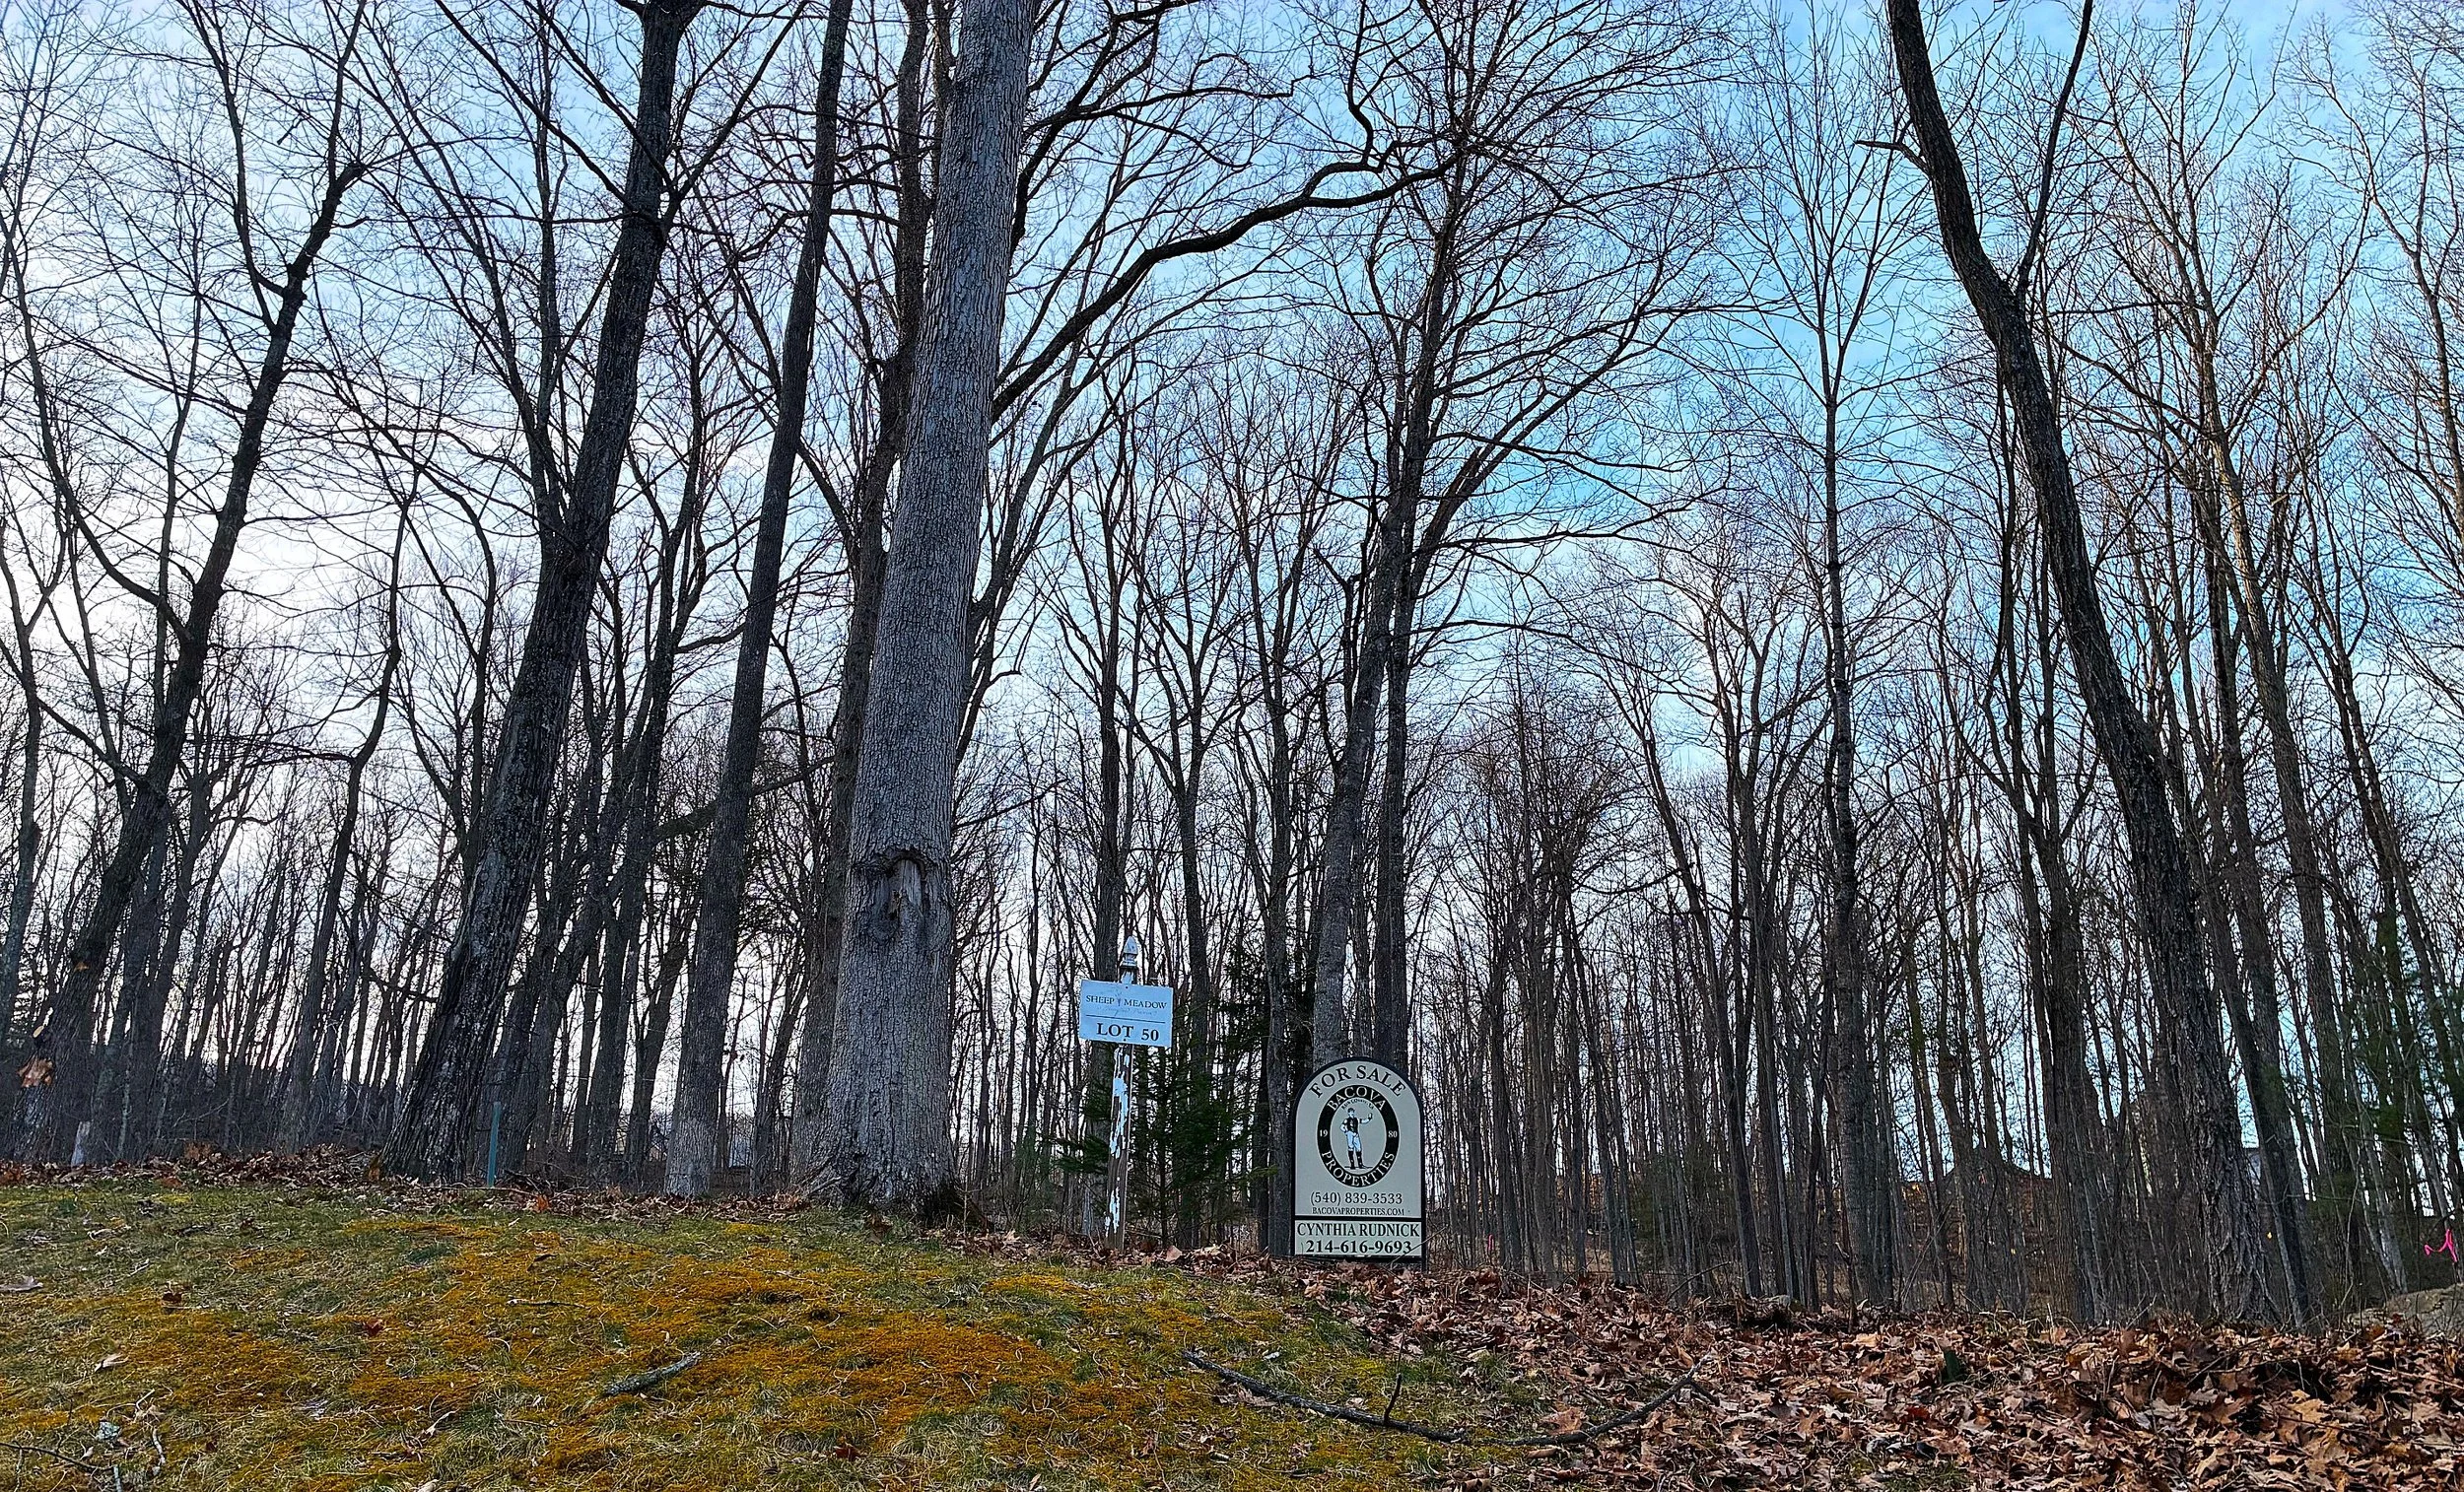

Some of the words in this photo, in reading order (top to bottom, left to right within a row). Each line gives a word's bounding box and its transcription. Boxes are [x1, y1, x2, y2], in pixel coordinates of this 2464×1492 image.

[1085, 995, 1115, 1004] SHEEP
[1124, 998, 1167, 1009] MEADOW
[1096, 1023, 1134, 1038] LOT
[1140, 1029, 1159, 1041] 50
[1308, 1066, 1352, 1099] FOR
[1356, 1064, 1407, 1096] SALE
[1327, 1086, 1387, 1112] BACOVA
[1321, 1151, 1395, 1187] PROPERTIES
[1310, 1191, 1341, 1205] (540)
[1344, 1192, 1403, 1204] 839-3533
[1312, 1207, 1404, 1216] BACOVAPROPERTIES.COM
[1297, 1223, 1356, 1237] CYNTHIA
[1359, 1223, 1420, 1237] RUDNICK
[1305, 1240, 1412, 1254] 214-616-9693
